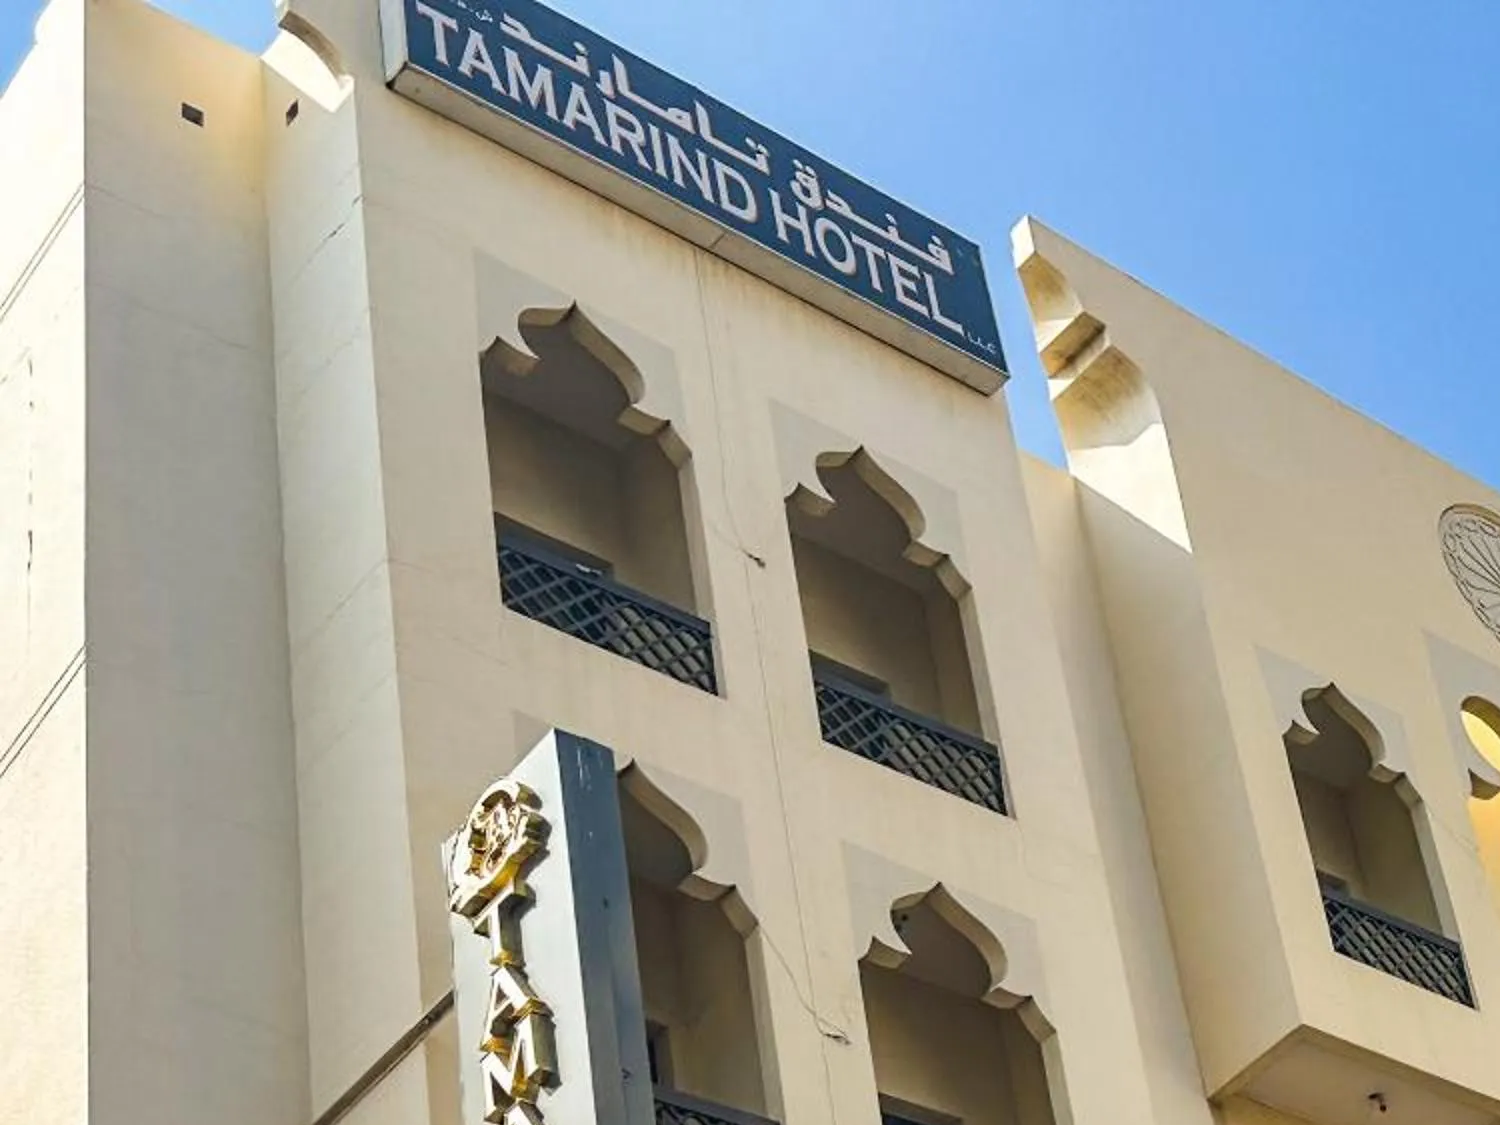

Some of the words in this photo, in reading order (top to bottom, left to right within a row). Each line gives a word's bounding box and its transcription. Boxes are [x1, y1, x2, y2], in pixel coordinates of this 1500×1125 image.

[415, 0, 759, 224] TAMARIND
[769, 185, 966, 337] HOTEL
[790, 159, 955, 276] فندق
